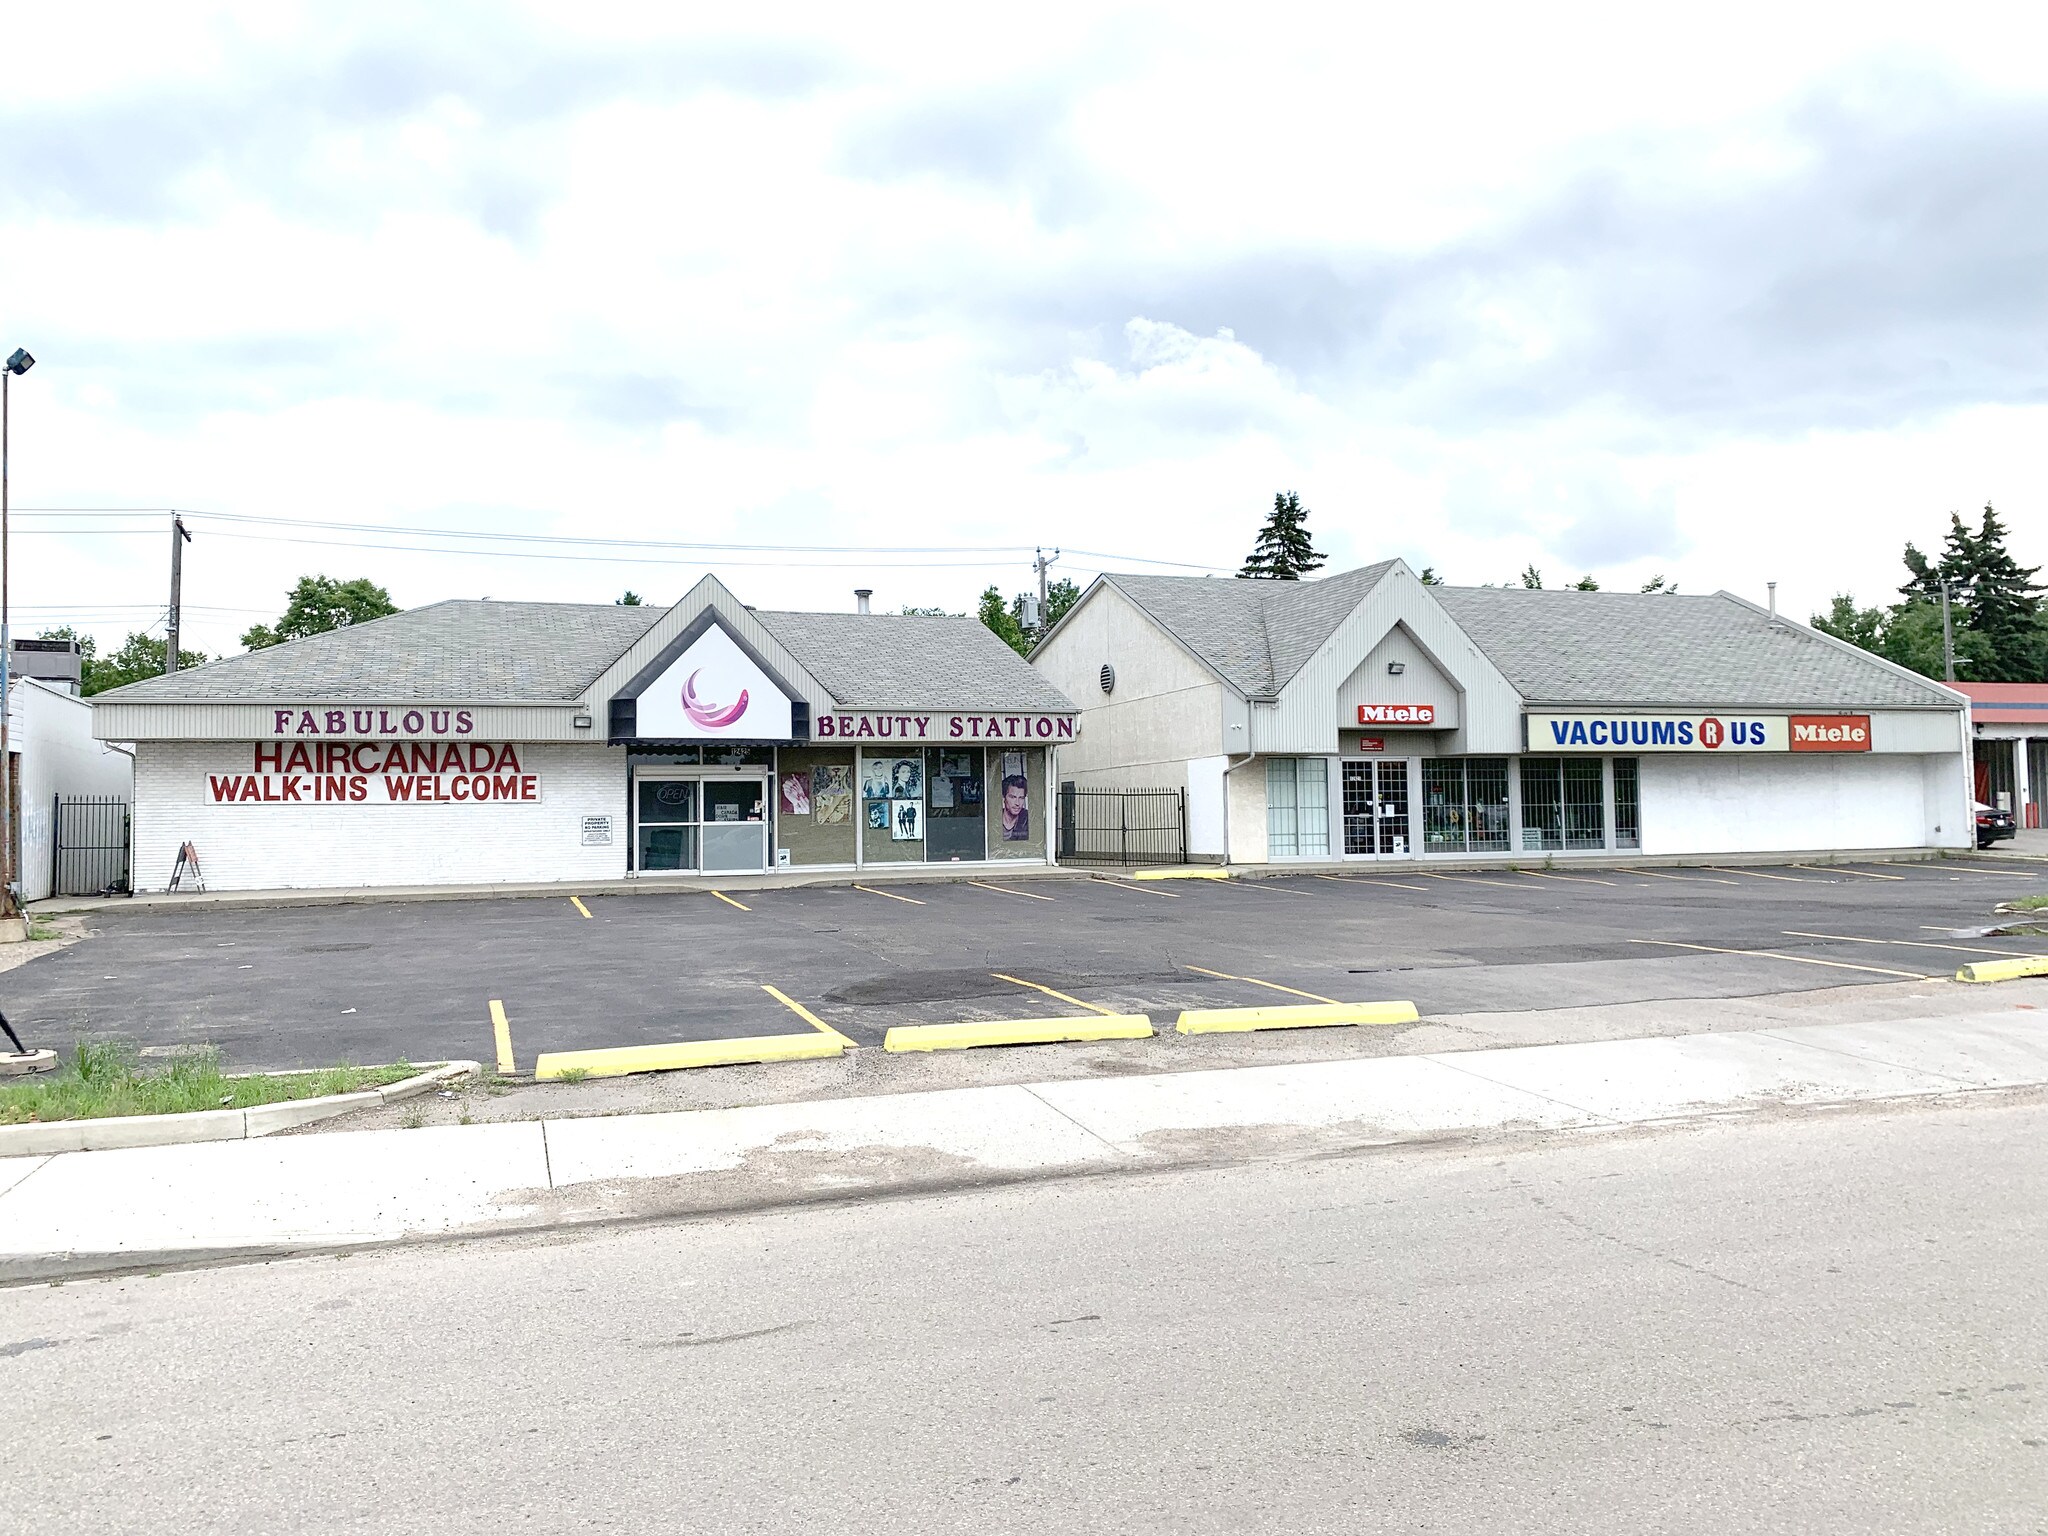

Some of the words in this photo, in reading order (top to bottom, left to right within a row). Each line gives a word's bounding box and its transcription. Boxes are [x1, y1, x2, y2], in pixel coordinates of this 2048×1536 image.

[274, 710, 474, 734] FABULOUS
[1363, 706, 1432, 722] Miele
[817, 715, 931, 737] BEAUTY
[950, 716, 1073, 738] STATION
[1550, 720, 1694, 745] VACUUMS
[1705, 722, 1718, 744] R
[1731, 722, 1766, 746] US
[1793, 724, 1866, 742] Miele
[254, 741, 522, 774] HAIRCANADA
[209, 775, 368, 802] WALK-INS
[384, 775, 538, 801] WELCOME
[660, 788, 688, 799] OPEN
